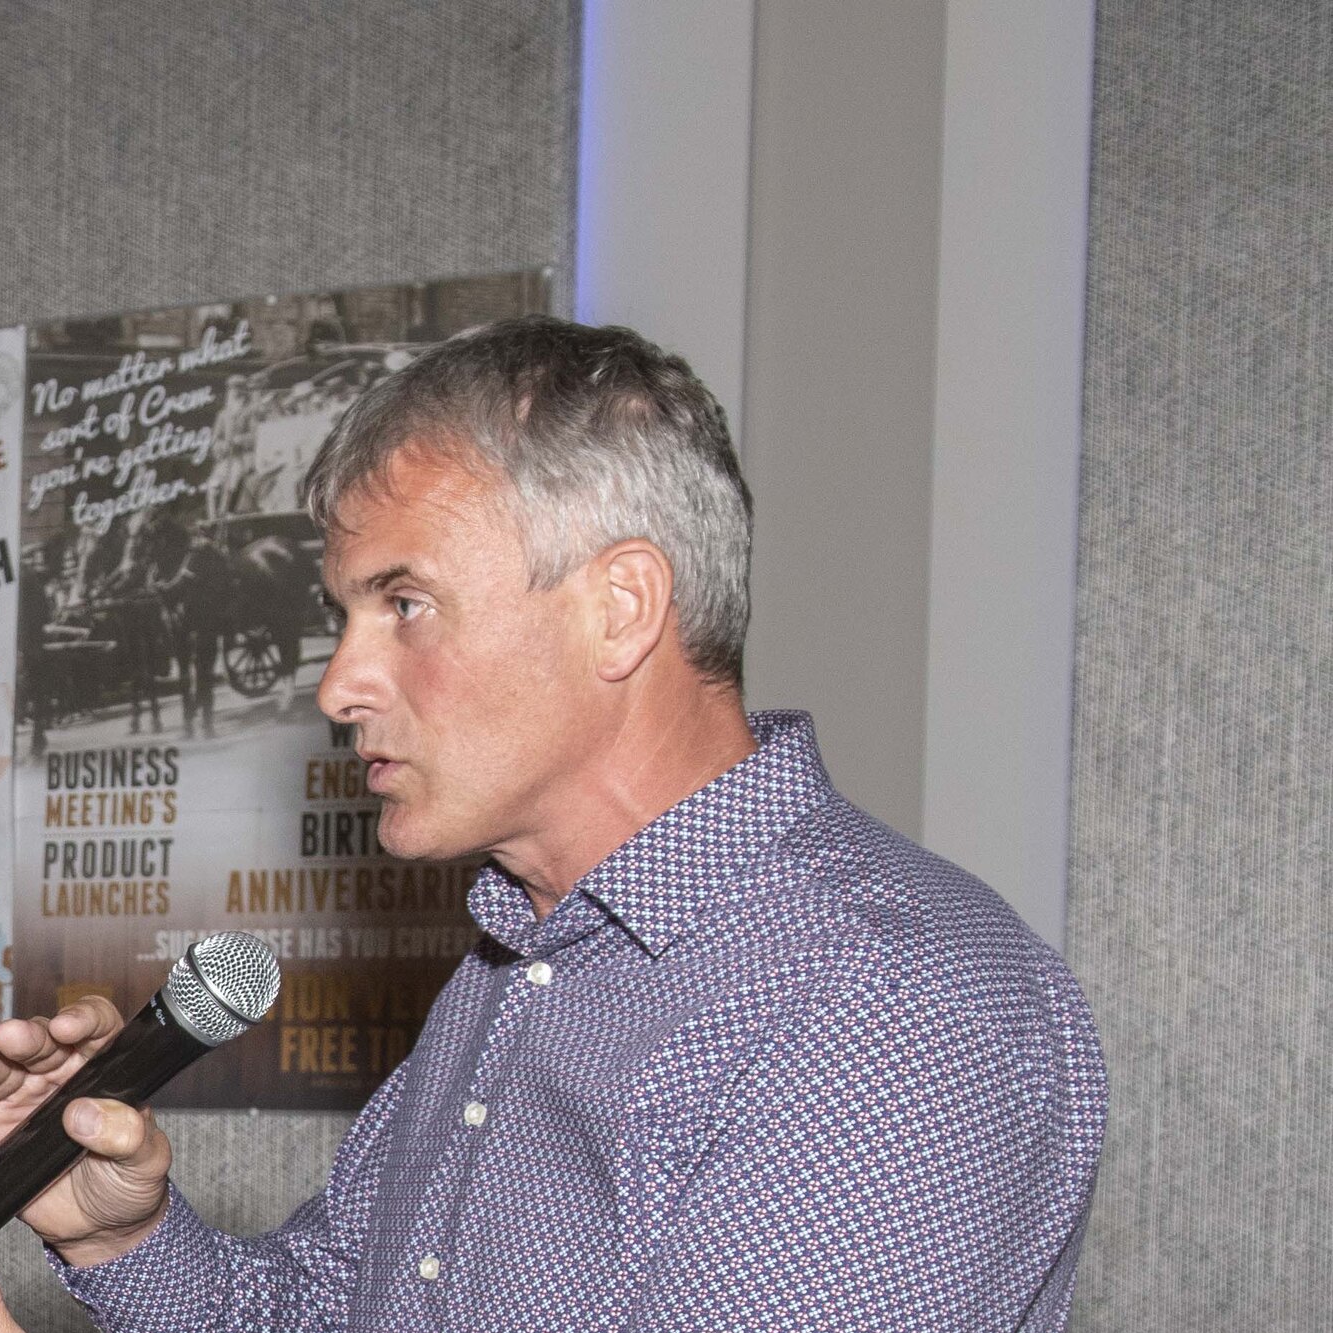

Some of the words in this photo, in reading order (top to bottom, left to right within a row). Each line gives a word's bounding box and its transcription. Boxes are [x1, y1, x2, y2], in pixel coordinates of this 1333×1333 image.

[31, 378, 79, 415] No
[81, 352, 176, 401] matter
[179, 320, 253, 375] what
[38, 404, 100, 452] sort
[102, 393, 136, 439] of
[139, 385, 216, 425] Crew
[27, 447, 114, 511] you're
[114, 425, 213, 487] getting
[47, 747, 179, 790] BUSINESS
[44, 790, 177, 827] MEETING'S
[44, 838, 174, 879] PRODUCT
[41, 881, 170, 917] LAUNCHES
[226, 866, 477, 915] ANNIVERSARIE
[298, 927, 344, 959] HAS
[350, 927, 389, 958] YOU
[395, 926, 477, 957] COVER
[280, 1026, 358, 1073] FREE
